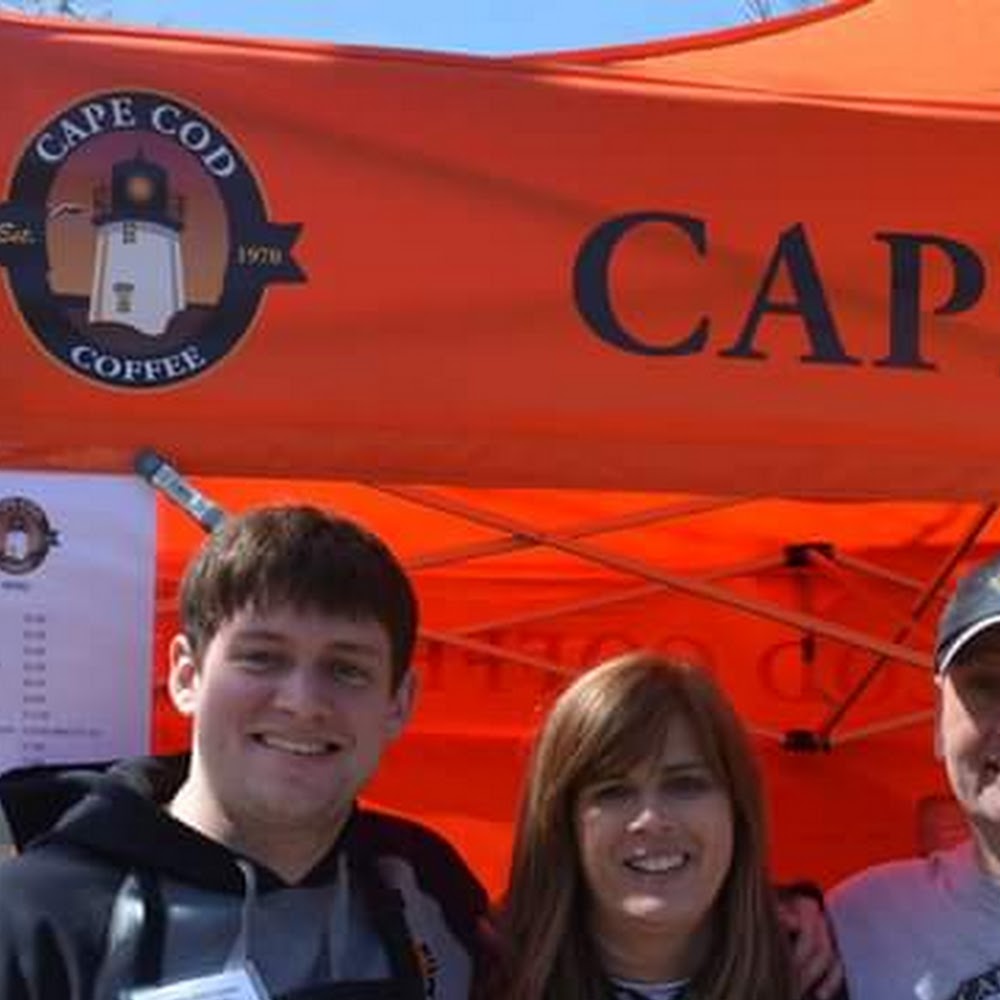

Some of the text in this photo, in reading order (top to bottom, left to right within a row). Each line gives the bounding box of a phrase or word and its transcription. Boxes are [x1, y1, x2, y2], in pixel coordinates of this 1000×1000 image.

[36, 97, 236, 177] CAPE COD
[70, 346, 206, 381] COFFEE
